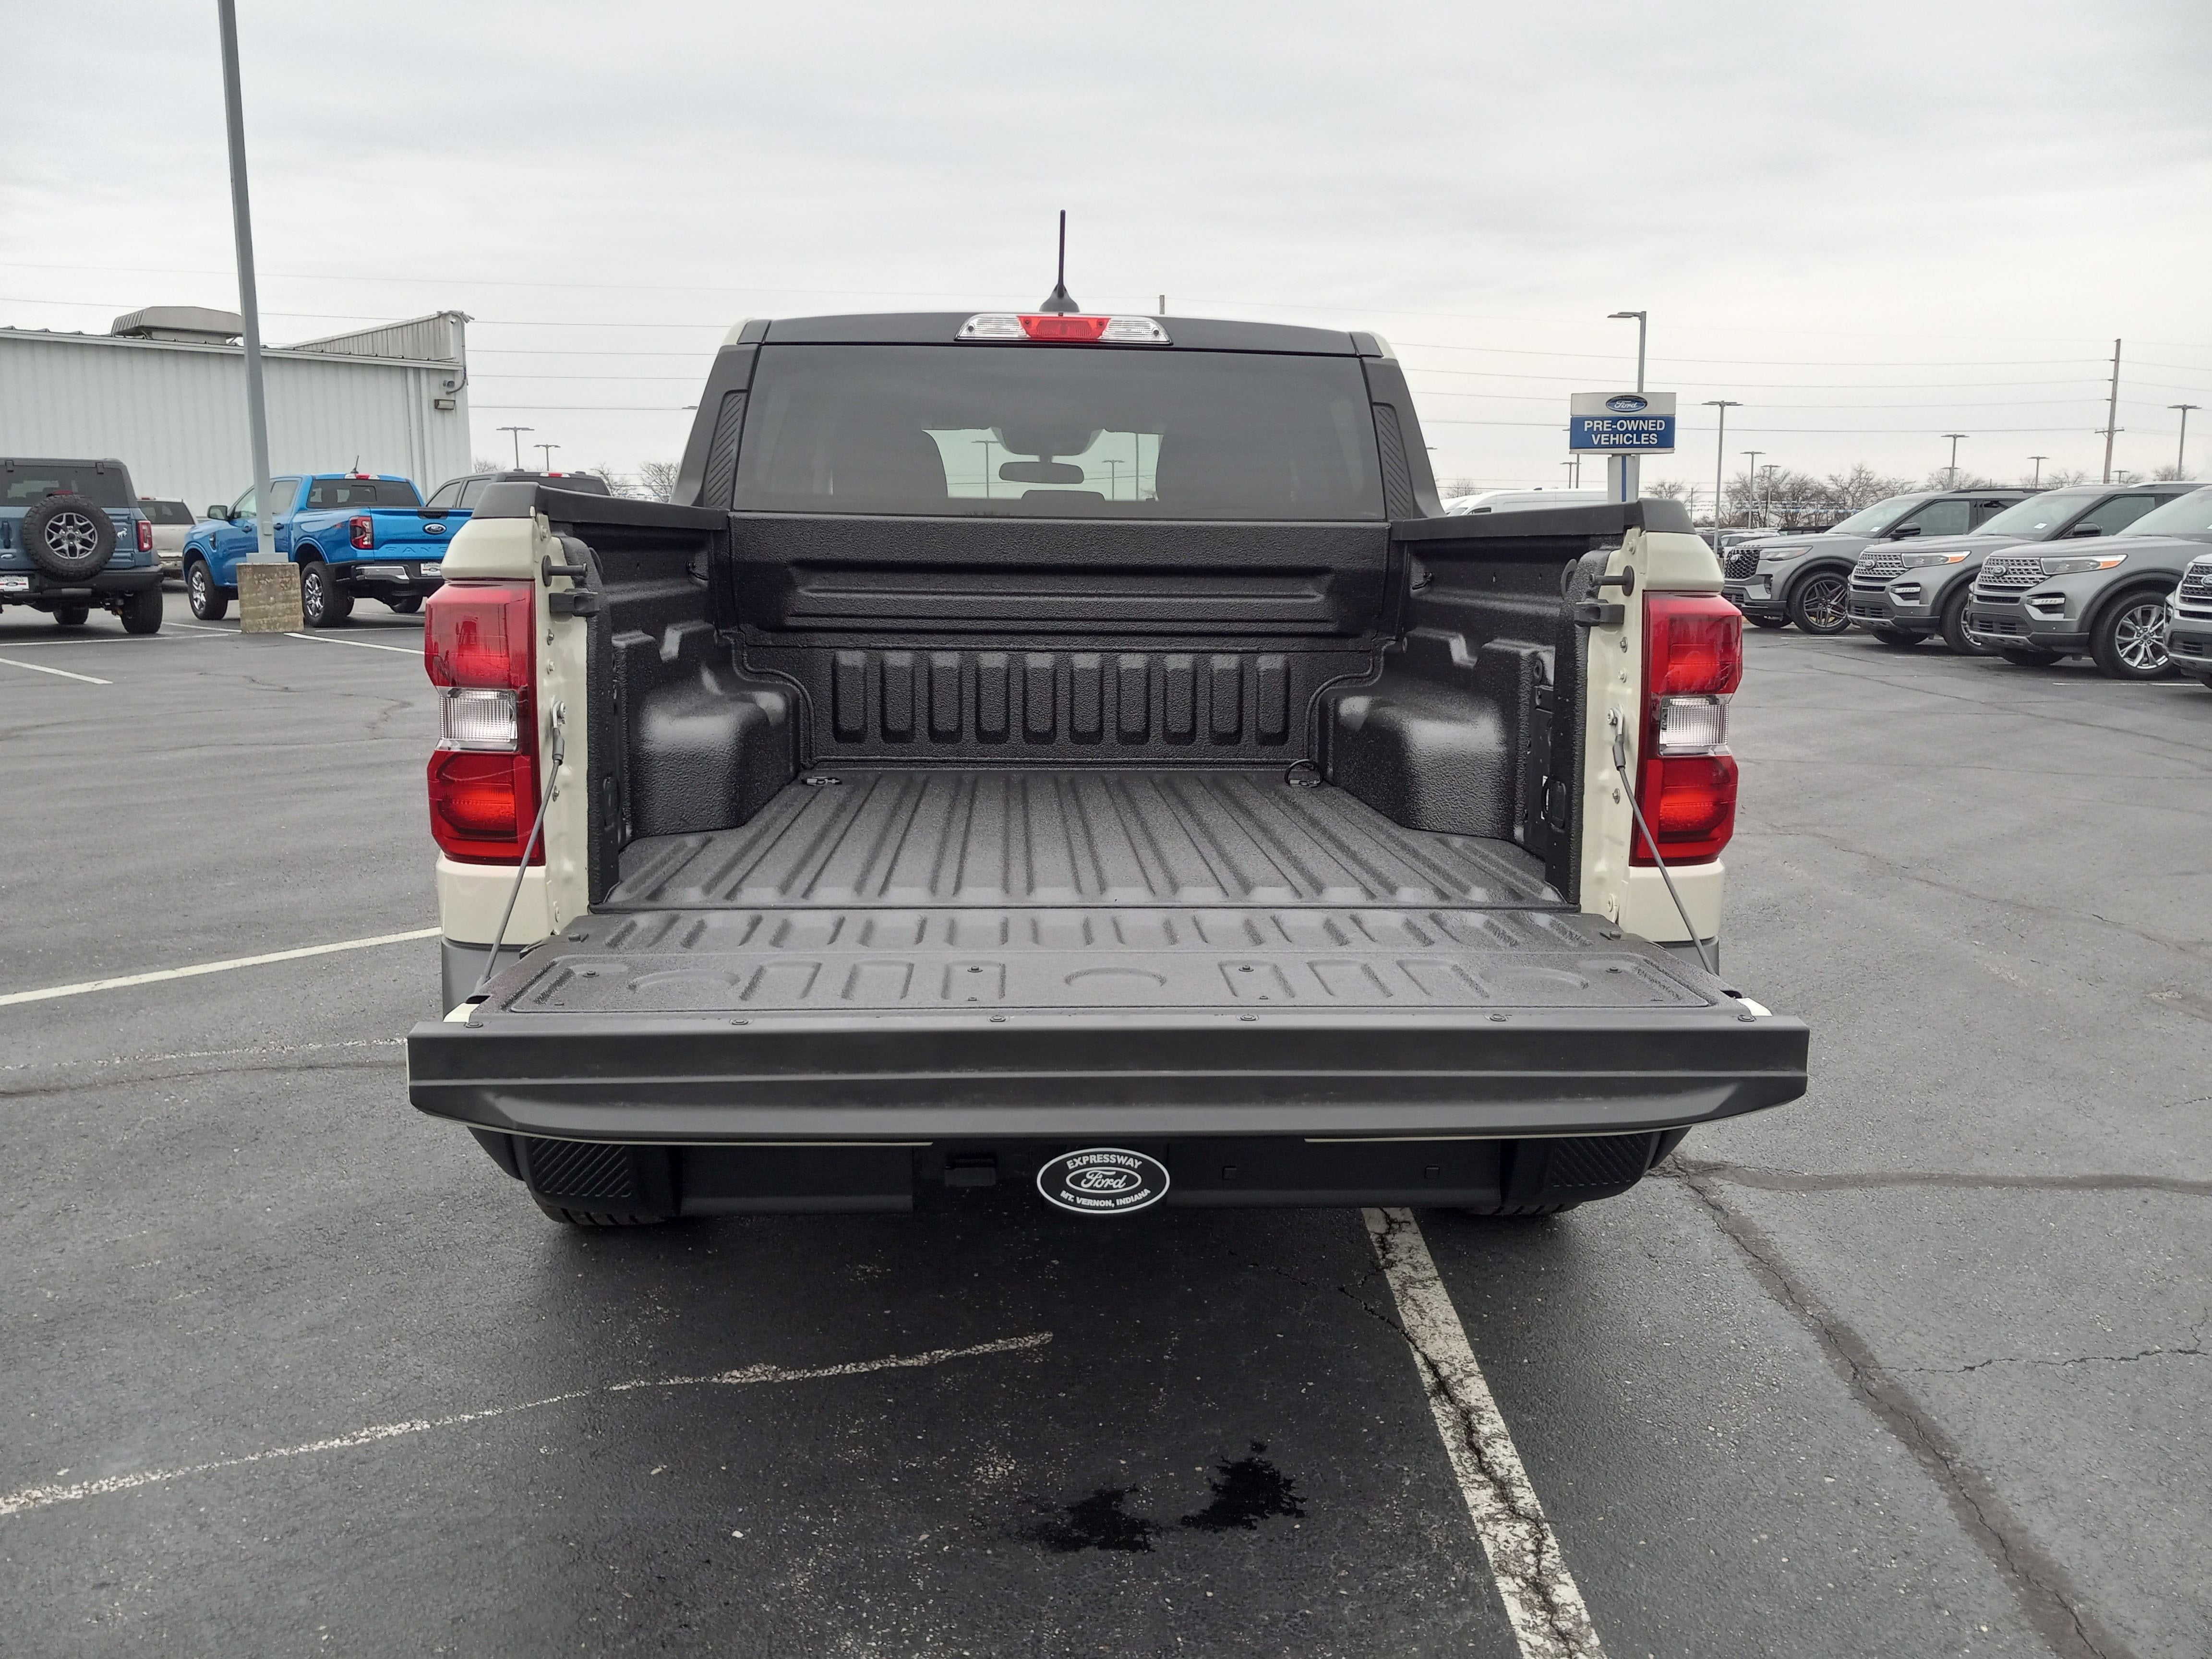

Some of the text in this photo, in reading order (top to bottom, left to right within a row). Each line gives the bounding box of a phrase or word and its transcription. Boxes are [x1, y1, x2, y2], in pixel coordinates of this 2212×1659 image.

[1614, 400, 1638, 409] Ford
[1584, 420, 1665, 432] PRE-OWNED
[1591, 433, 1658, 445] VEHICLES
[1066, 1154, 1142, 1170] EXPRESSWAY
[1081, 1170, 1127, 1189] Ford
[1060, 1189, 1151, 1208] MT. VERNON, INDIANA
